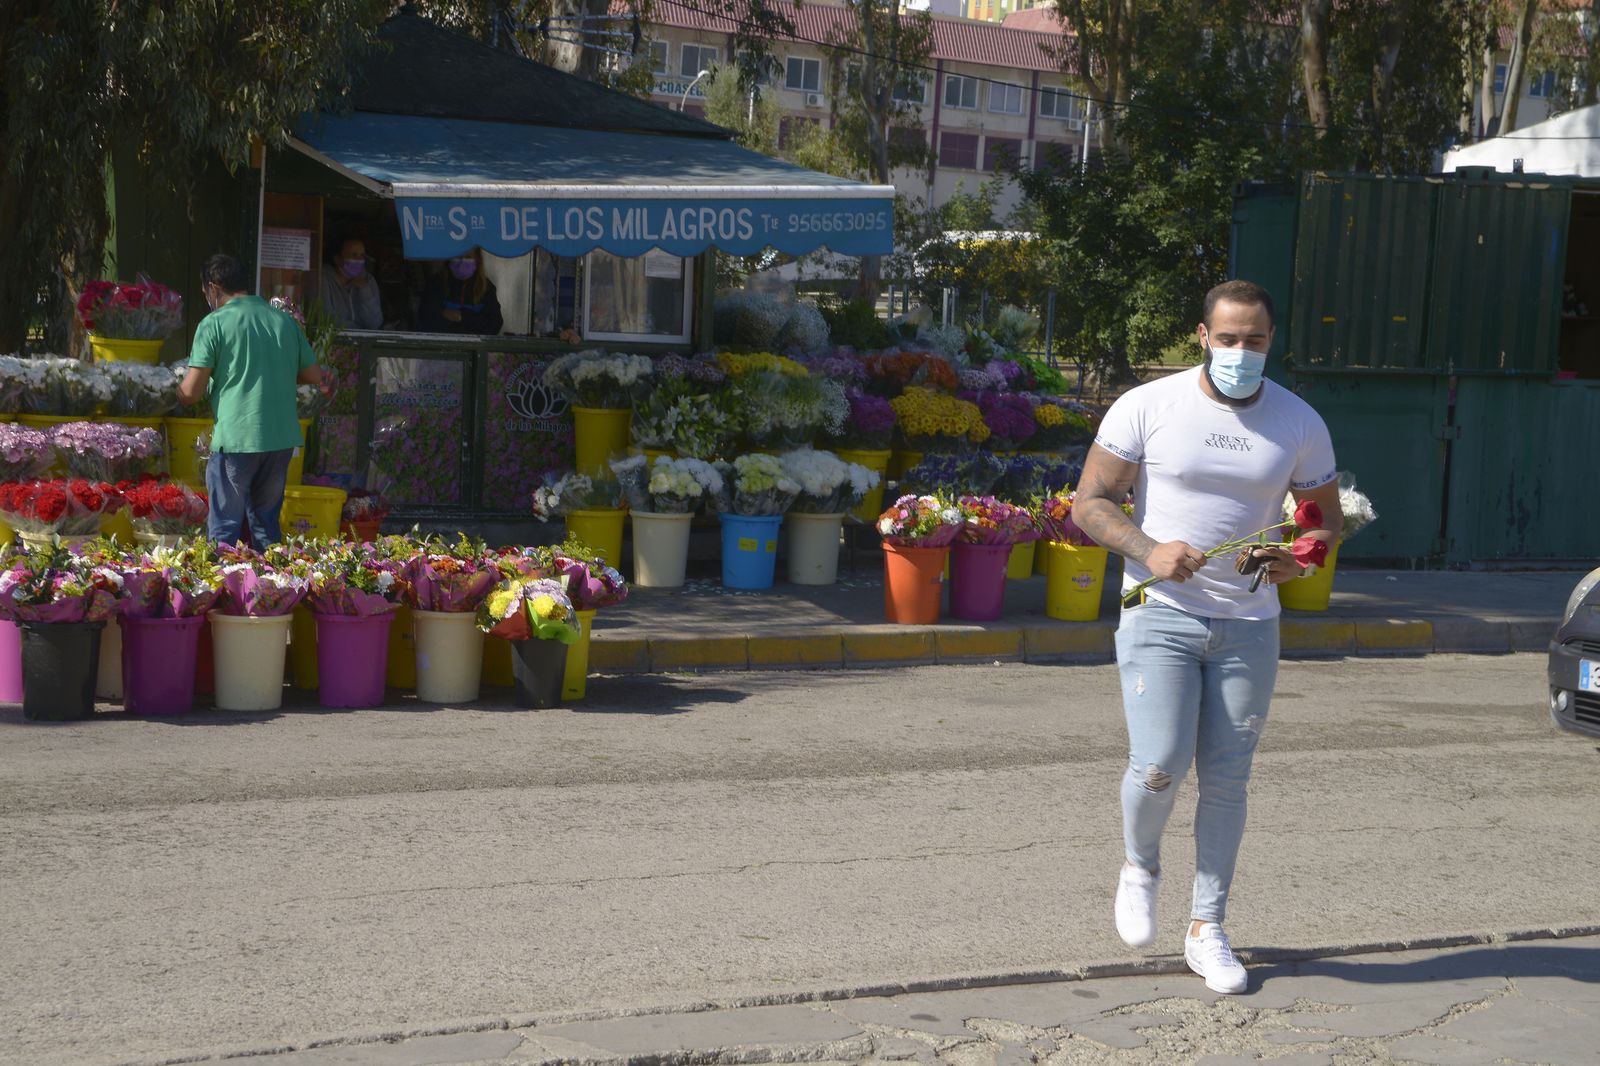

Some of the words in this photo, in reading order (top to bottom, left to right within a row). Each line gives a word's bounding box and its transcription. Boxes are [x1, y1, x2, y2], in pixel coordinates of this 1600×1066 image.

[500, 206, 539, 241] DE
[546, 206, 604, 241] LOS
[612, 206, 753, 241] MILAGROS
[788, 211, 887, 232] 956663095
[1210, 432, 1249, 446] TRUST
